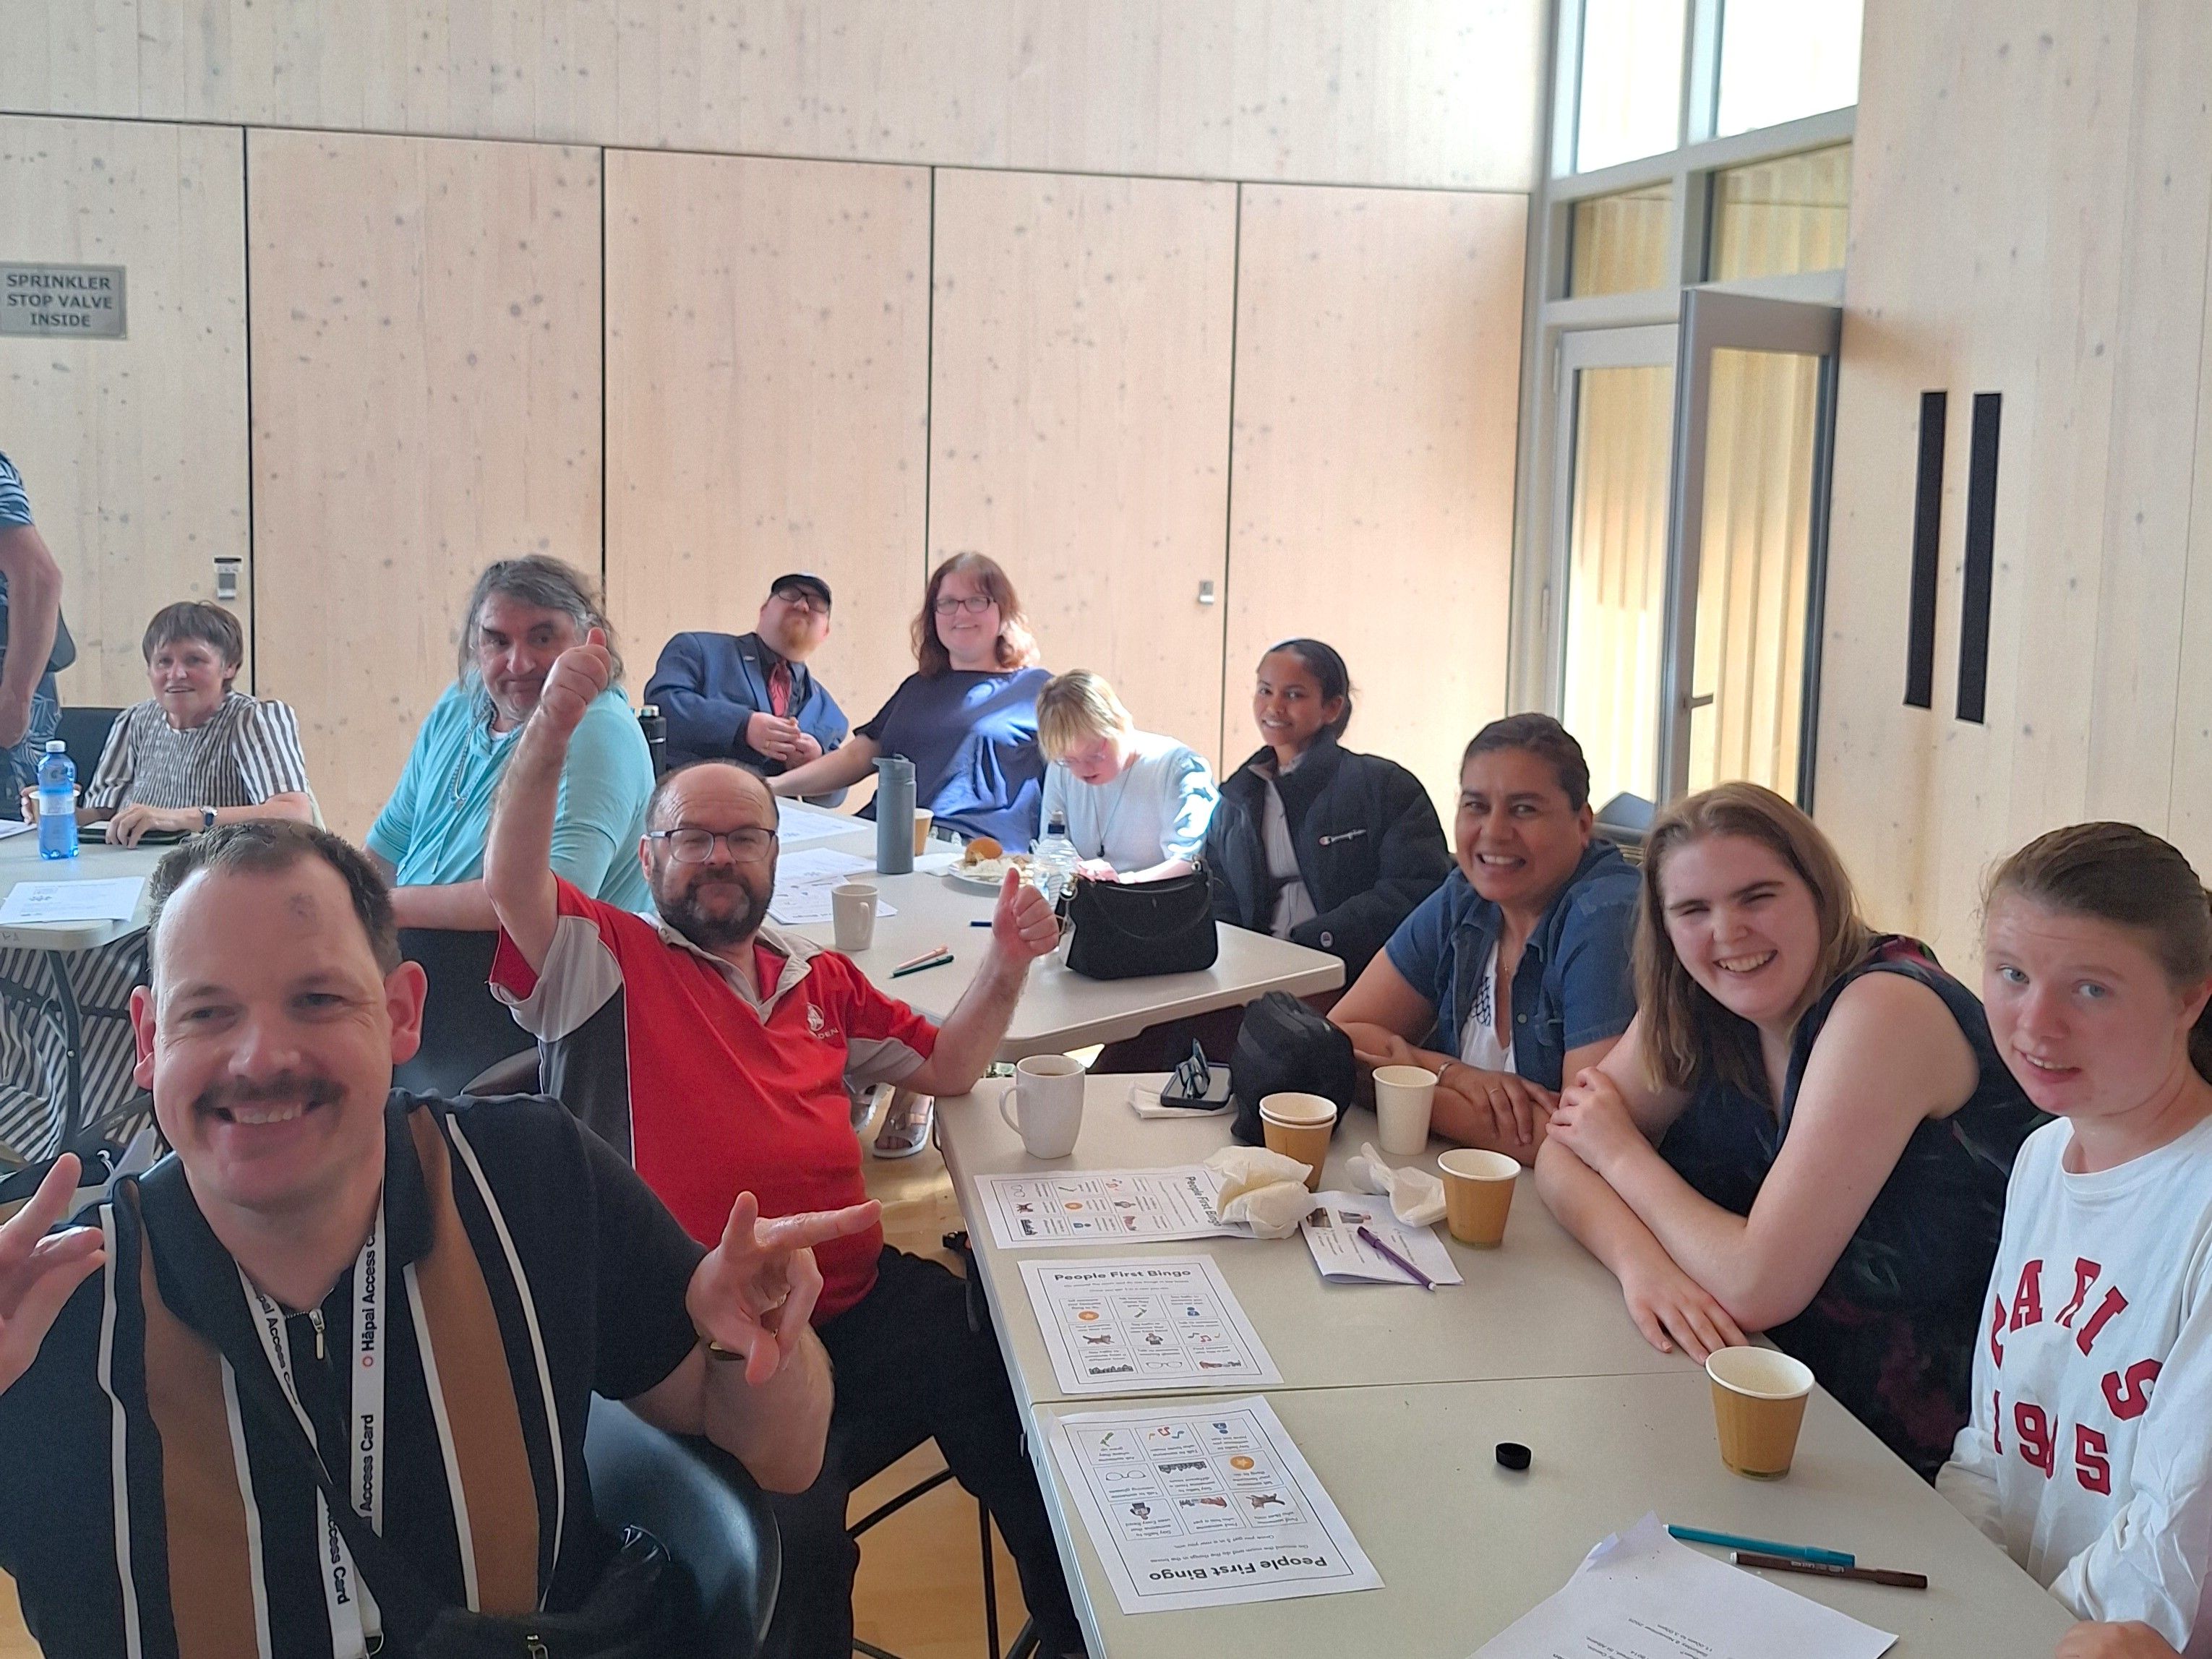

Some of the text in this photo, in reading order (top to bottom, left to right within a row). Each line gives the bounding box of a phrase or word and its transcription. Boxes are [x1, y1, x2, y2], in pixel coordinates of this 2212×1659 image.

[6, 273, 111, 291] SPRINKLER
[7, 293, 113, 309] STOP VALVE
[31, 312, 92, 327] INSIDE
[1185, 1176, 1204, 1196] People
[361, 1249, 376, 1305] Access
[1053, 1272, 1107, 1282] People
[1146, 1269, 1191, 1278] Bingo
[361, 1308, 377, 1352] Hāpai
[359, 1414, 374, 1512] Access Card
[1149, 1556, 1327, 1581] People First Bingo
[333, 1566, 351, 1606] Card
